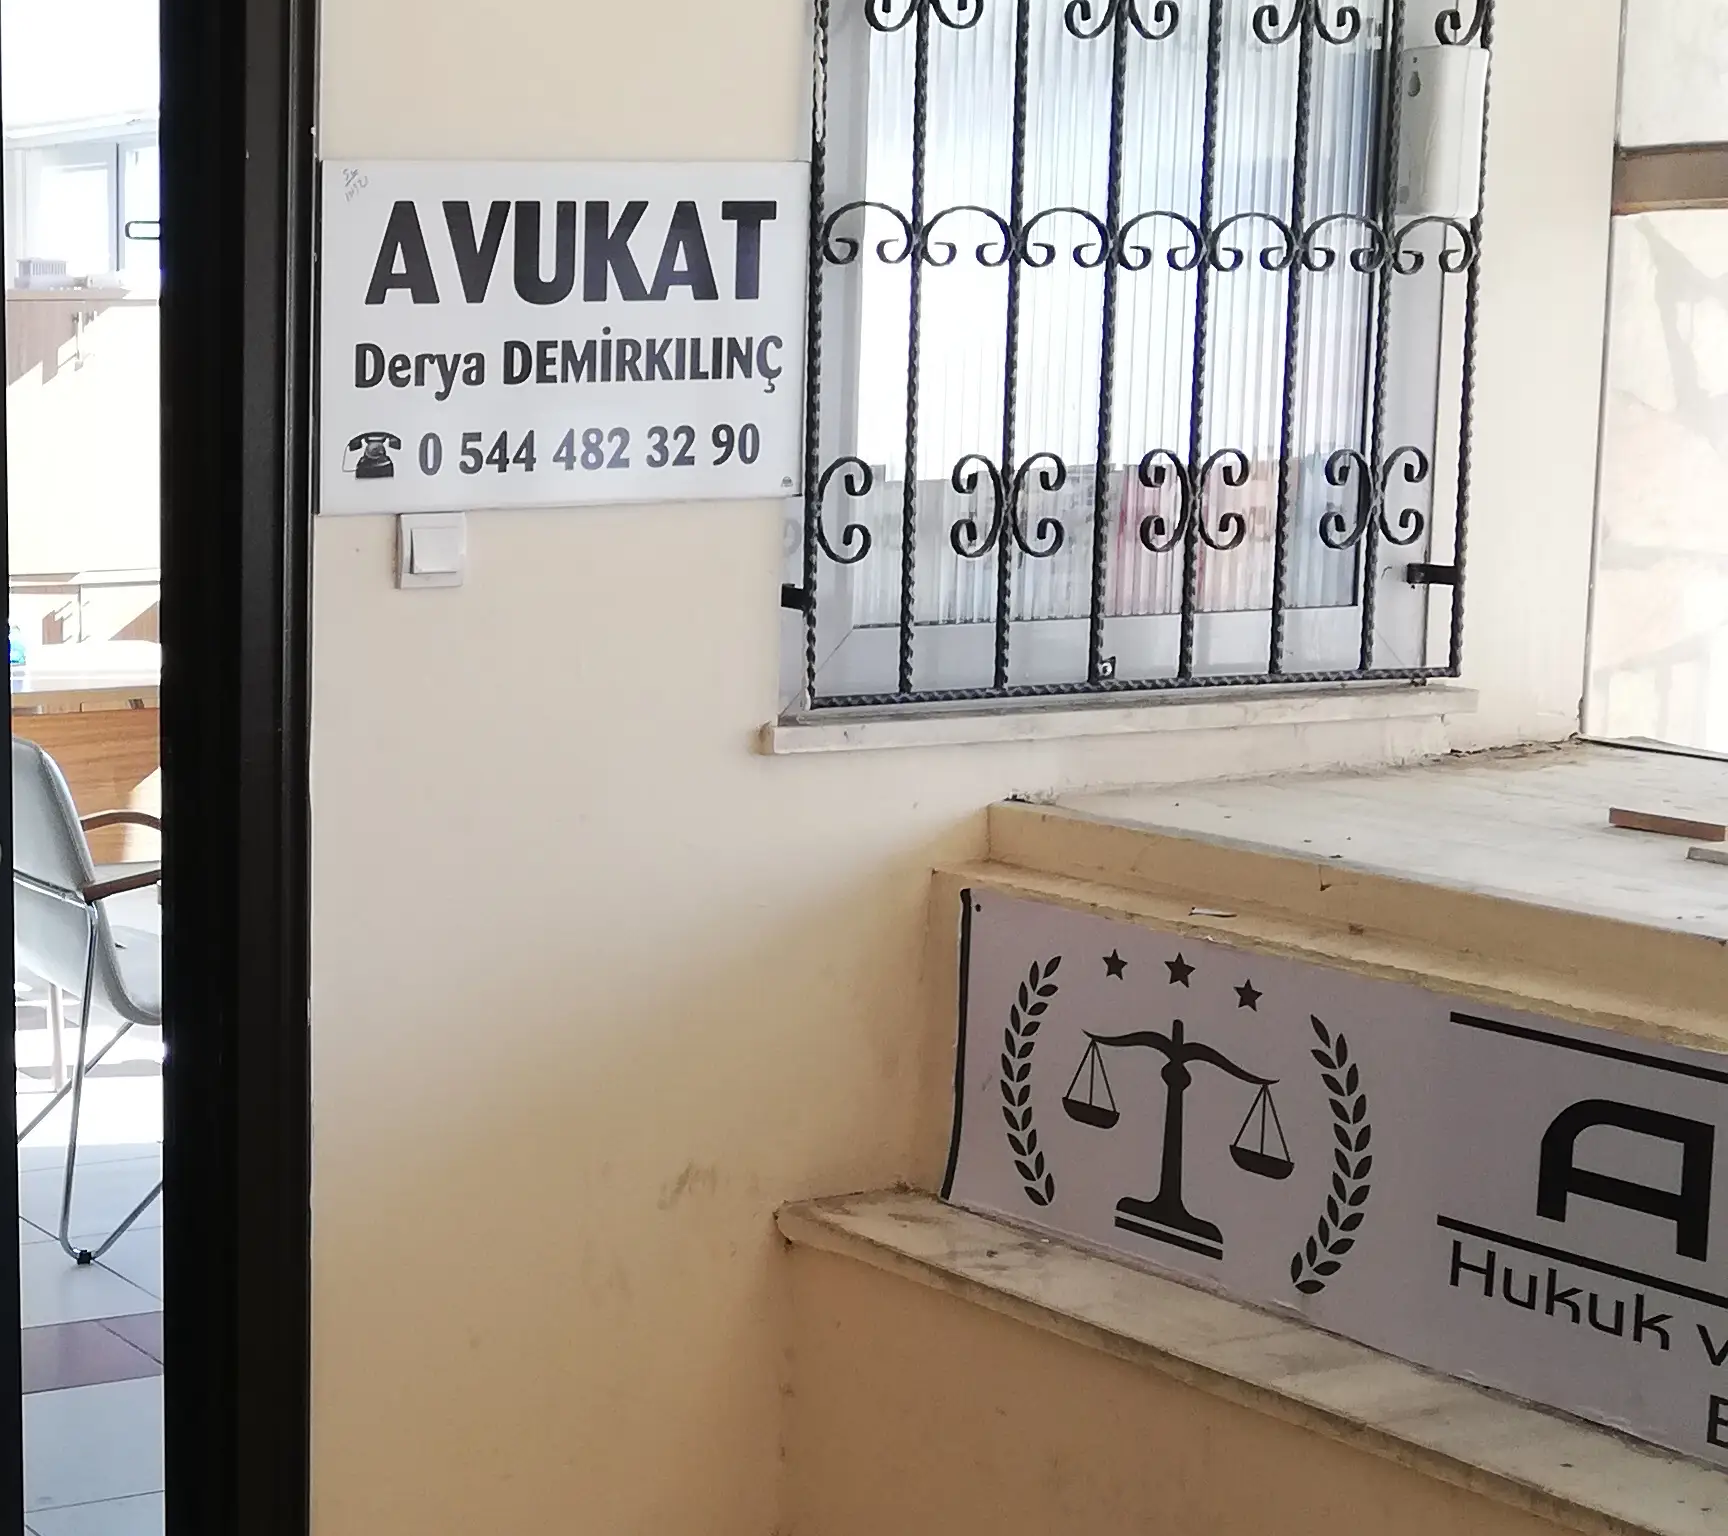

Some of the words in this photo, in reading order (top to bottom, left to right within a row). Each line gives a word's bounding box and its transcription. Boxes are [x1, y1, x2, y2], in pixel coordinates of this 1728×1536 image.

[364, 199, 778, 306] AVUKAT
[354, 342, 486, 402] Derya
[502, 325, 784, 395] DEMİRKILINÇ
[418, 432, 443, 476] 0
[459, 429, 537, 475] 544
[552, 427, 631, 471] 482
[646, 424, 696, 468] 32
[711, 422, 760, 466] 90
[1449, 1239, 1674, 1351] Hukuk
[1695, 1323, 1728, 1367] v
